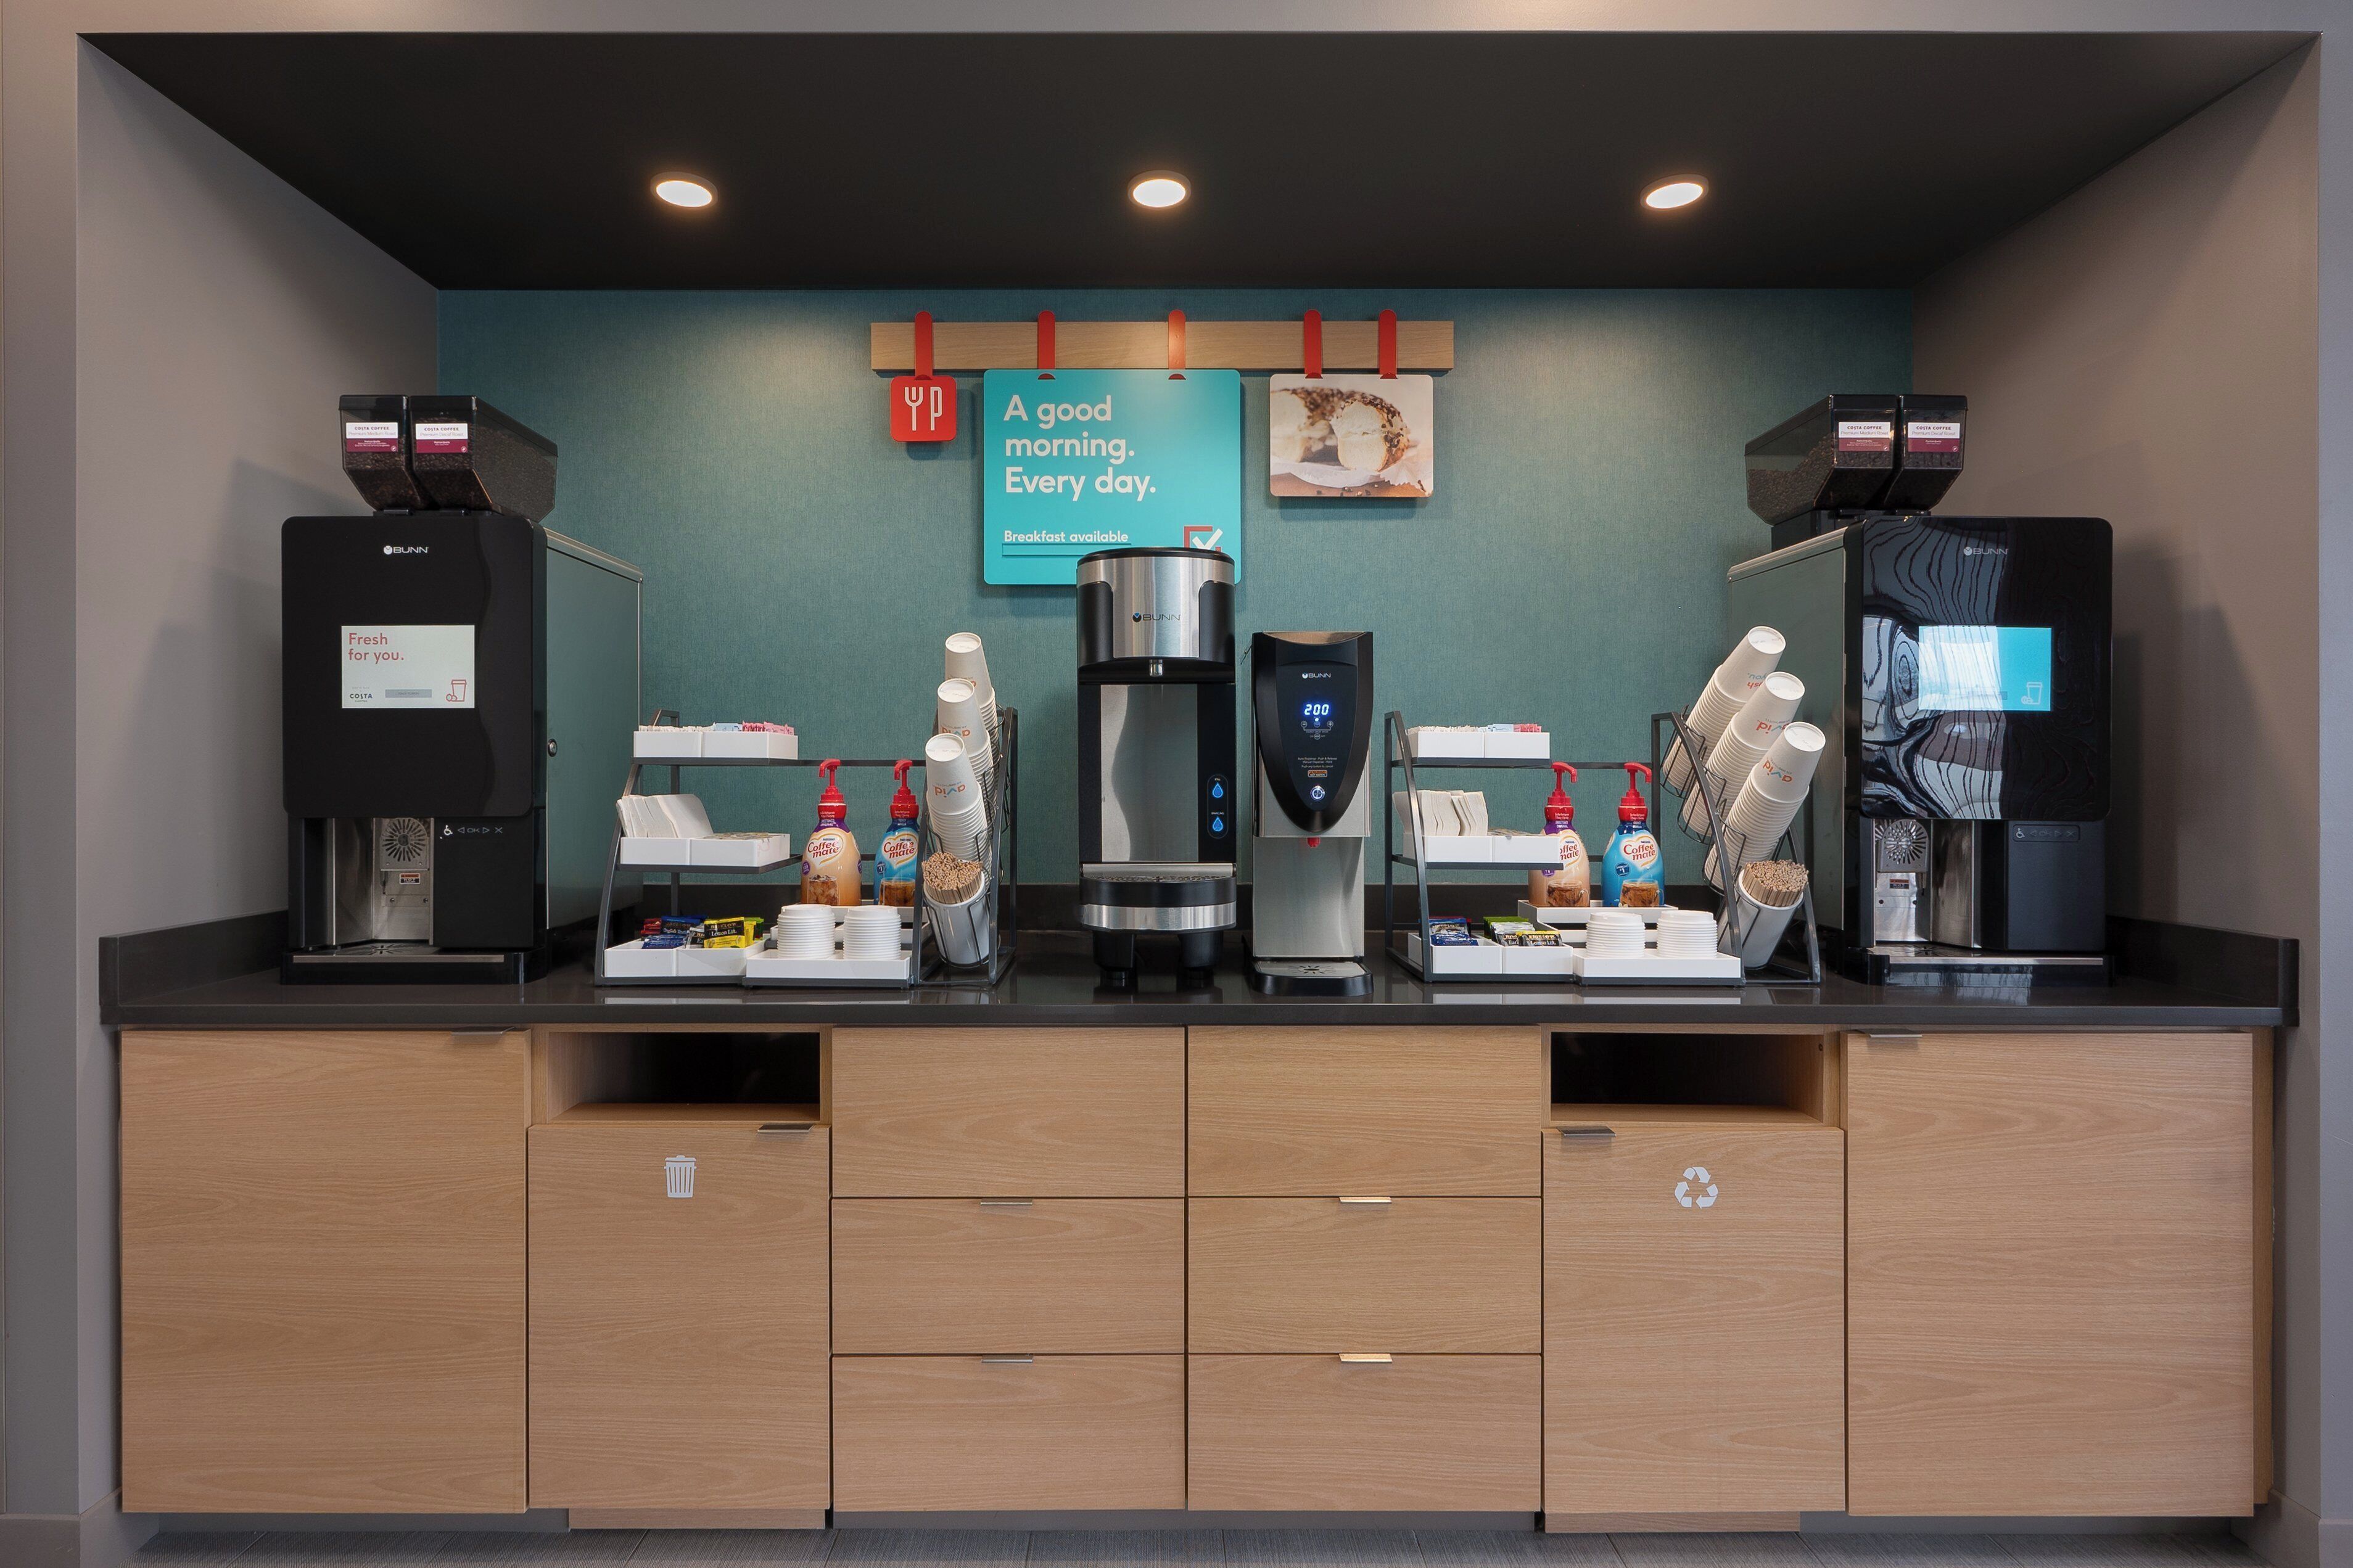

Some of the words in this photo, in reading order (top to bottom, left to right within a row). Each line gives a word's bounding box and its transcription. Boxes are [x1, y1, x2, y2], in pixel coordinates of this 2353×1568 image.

[1003, 395, 1028, 421] A
[1037, 395, 1111, 429] good
[1005, 432, 1134, 464] morning.
[1006, 467, 1086, 501] Every
[1095, 467, 1156, 501] day.
[1004, 530, 1065, 543] Breakfast
[1069, 531, 1129, 543] available
[348, 633, 388, 645] Fresh
[348, 649, 369, 660] for
[374, 652, 404, 664] you.
[1304, 704, 1330, 715] 200
[1763, 760, 1793, 782] avid
[934, 784, 966, 798] avid
[807, 841, 839, 853] Coffee
[812, 847, 839, 858] mate
[883, 842, 914, 853] Coffee
[889, 848, 915, 858] mate
[1559, 844, 1578, 854] offee
[1623, 844, 1654, 855] Coffee
[1632, 850, 1655, 861] mate
